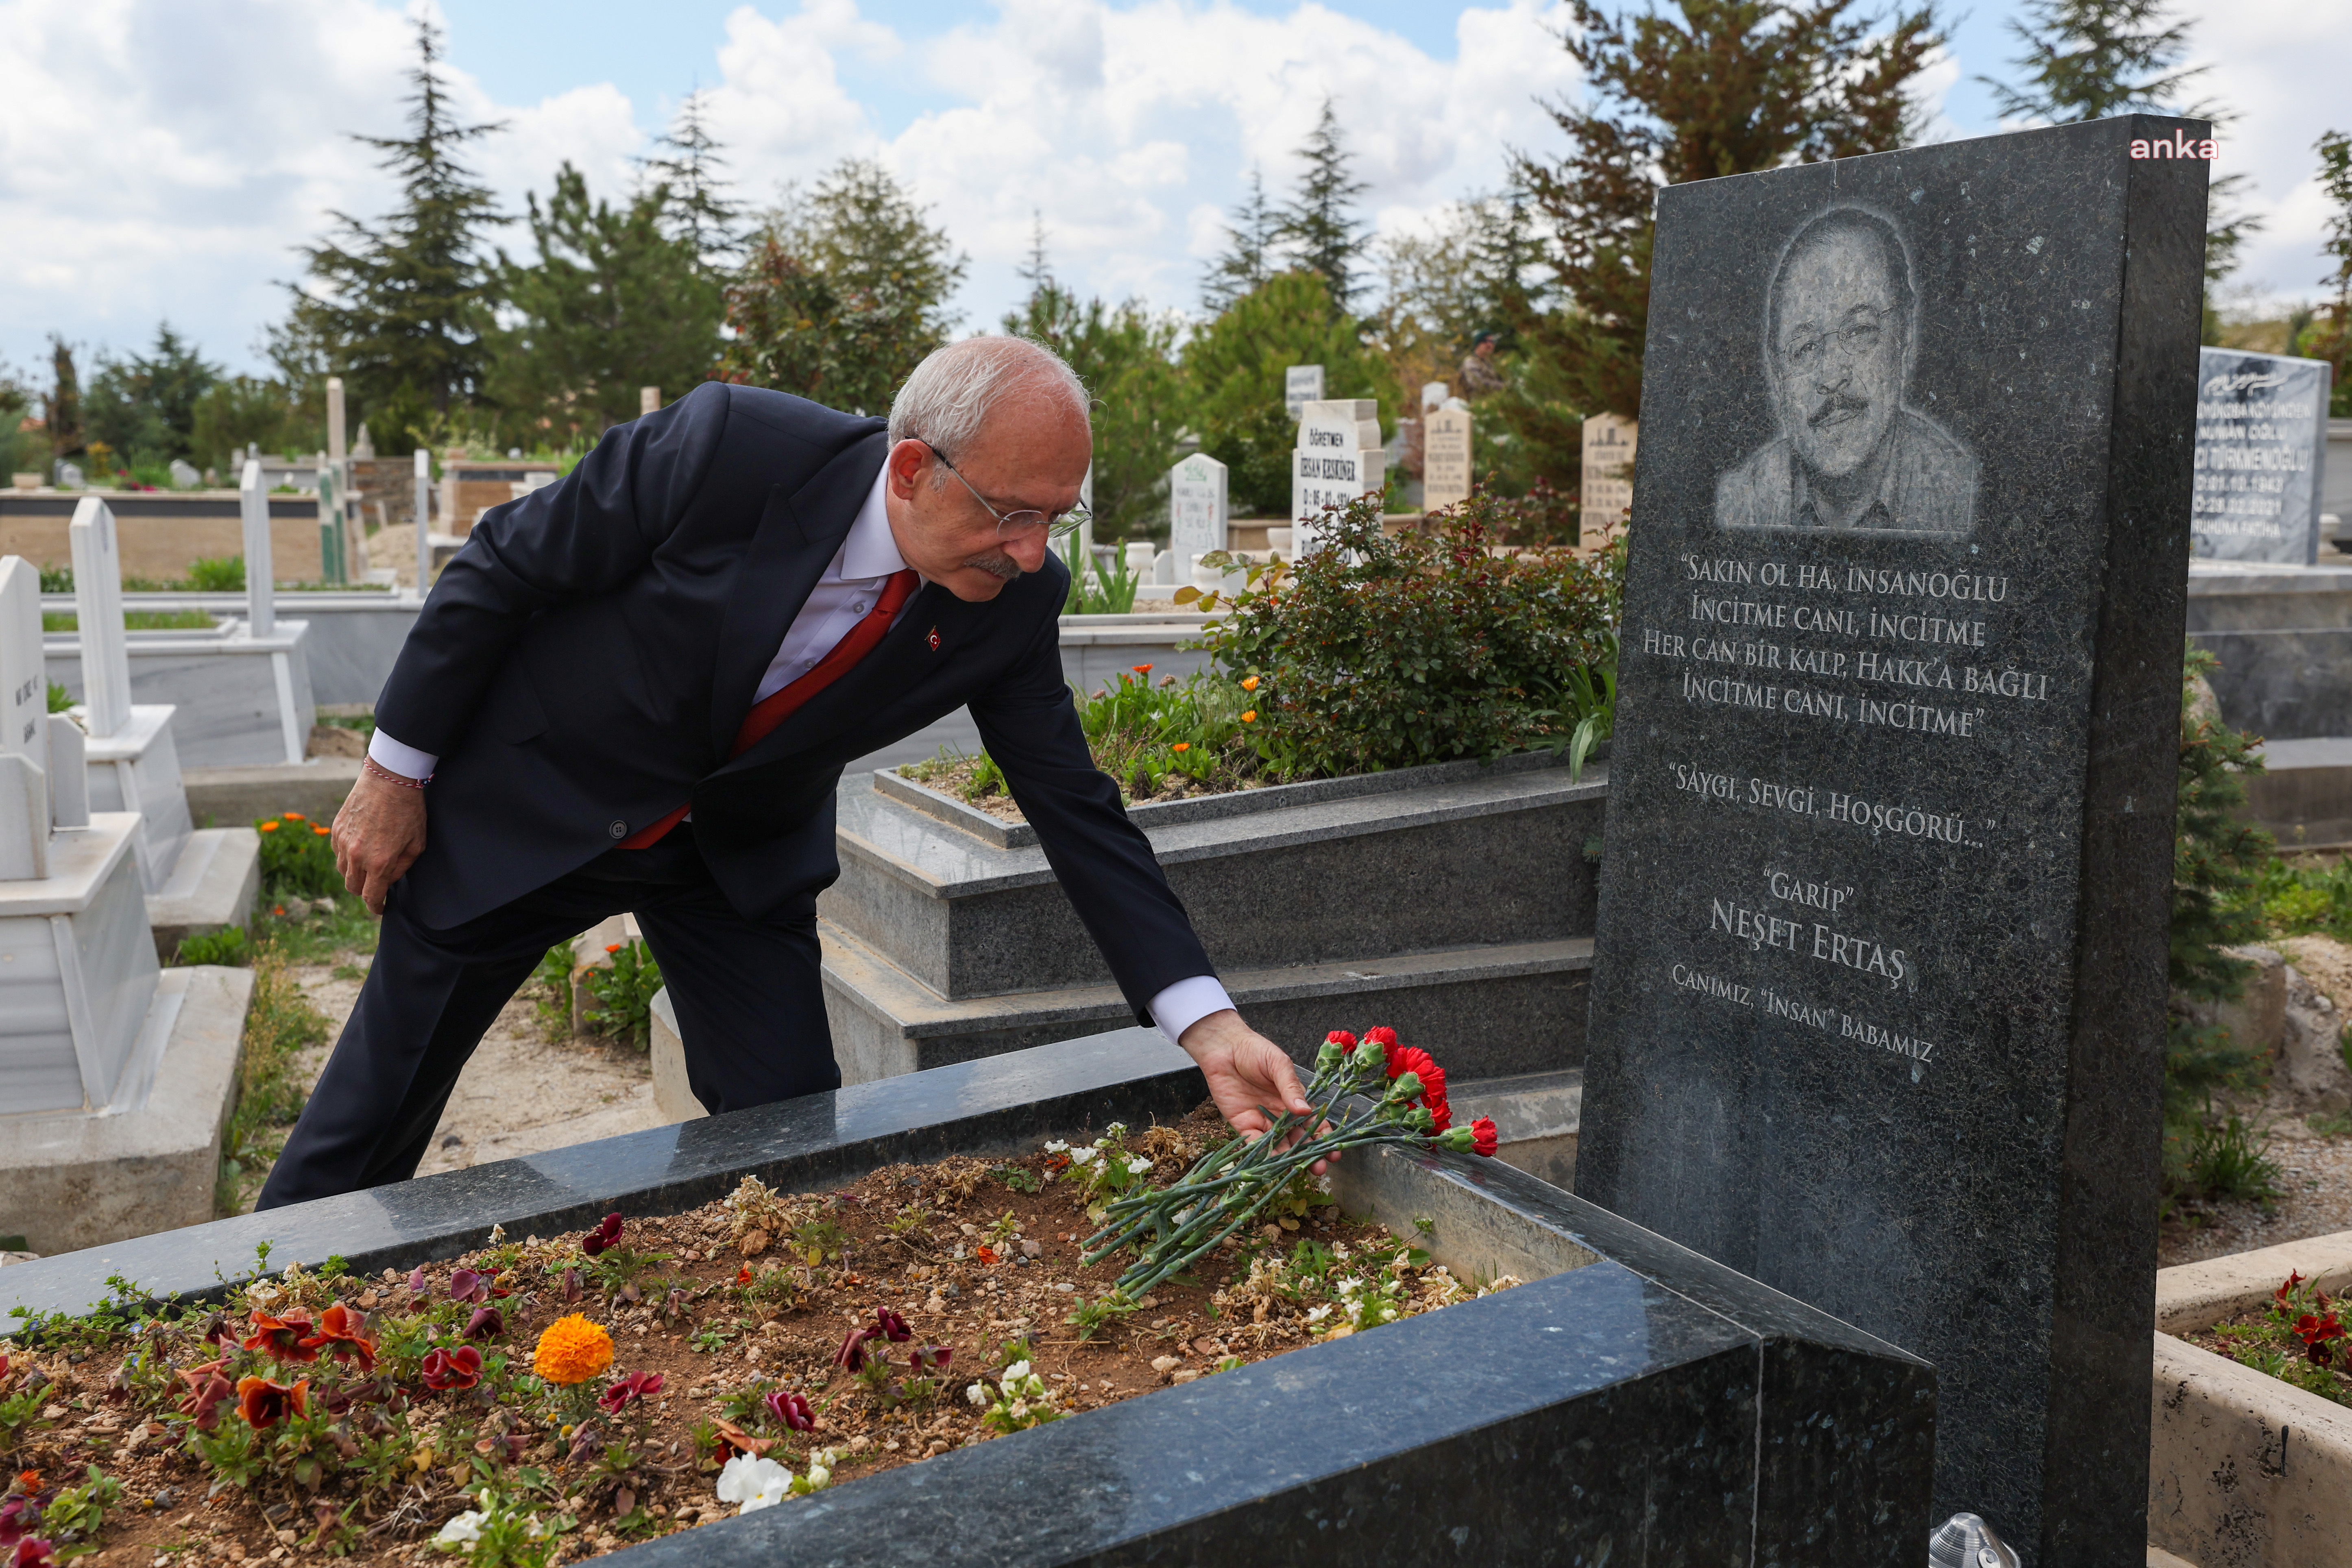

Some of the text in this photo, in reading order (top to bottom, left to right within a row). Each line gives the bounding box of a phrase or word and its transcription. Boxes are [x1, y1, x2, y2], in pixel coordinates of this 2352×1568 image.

[1309, 429, 1343, 447] ÖĞRETMEN
[1681, 552, 2008, 602] “SAKIN OL HA, İNSANOĞLU
[1691, 589, 1986, 647] İNCİTME CANI, İNCİTME
[1643, 629, 1687, 657] HER
[1692, 637, 1737, 664] CAN
[1745, 639, 1783, 669] BİR
[1789, 648, 1846, 680] KALP,
[1964, 664, 2048, 700] BAĞLI
[1683, 667, 1985, 737] İNCİTME CANI, İNCİTME”
[1669, 761, 1740, 805] “SAYGI,
[1749, 778, 1819, 819] SEVGİ,
[1763, 867, 1854, 912] “GARİP”
[1710, 897, 1905, 989] NEŞET ERTAŞ
[1672, 964, 1933, 1062] CANIMIZ, “İNSAN” BABAMIZ
